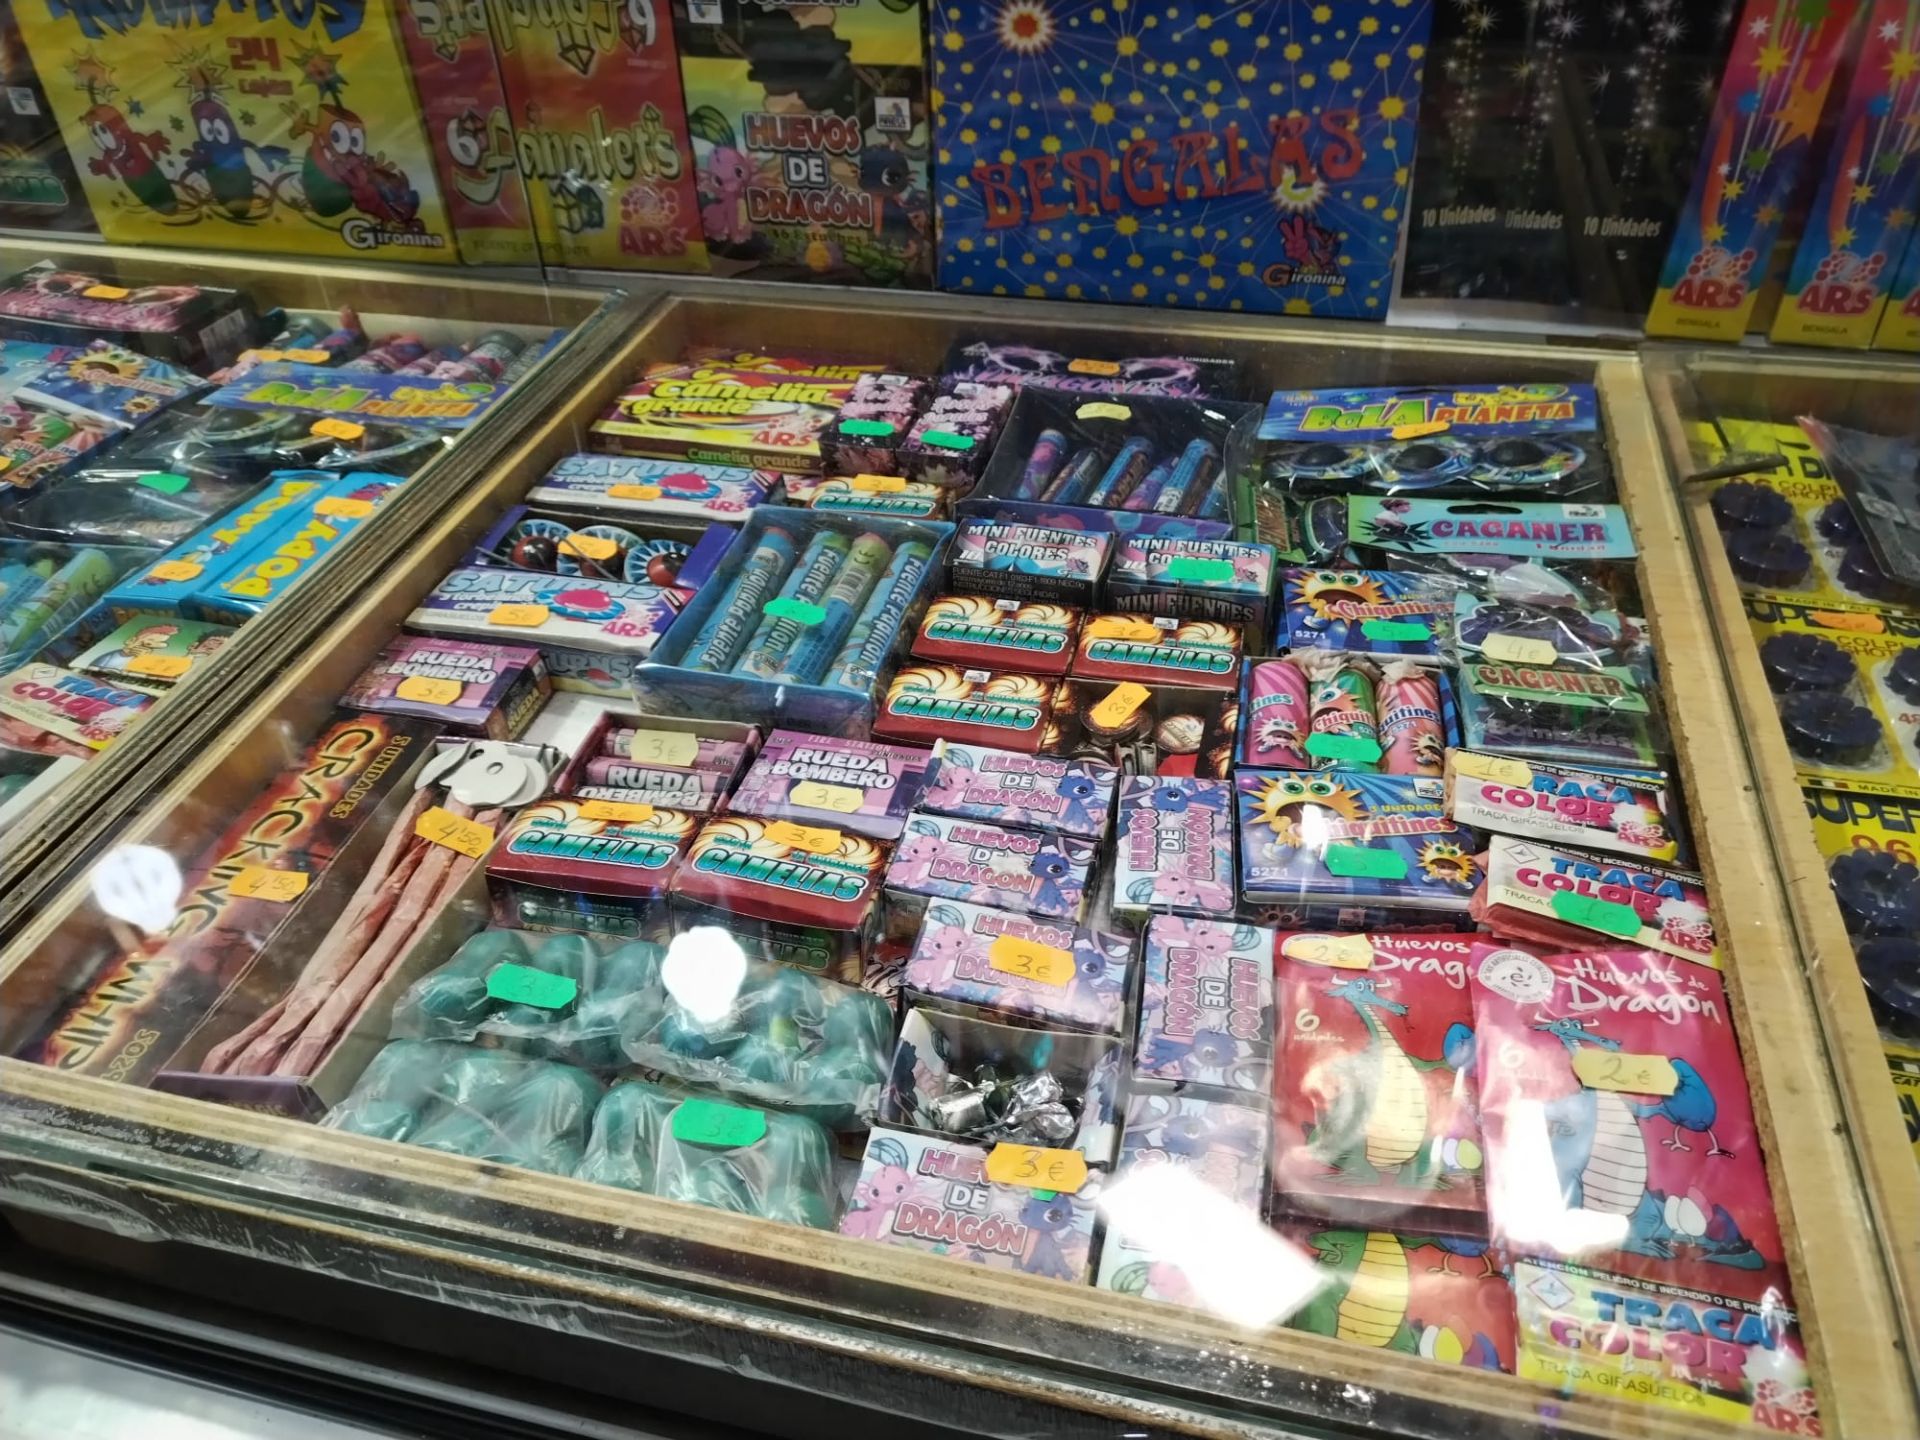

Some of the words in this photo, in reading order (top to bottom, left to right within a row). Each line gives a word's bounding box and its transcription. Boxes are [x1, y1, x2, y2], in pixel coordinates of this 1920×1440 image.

[227, 37, 281, 71] 24
[743, 112, 862, 156] HUEVOS
[784, 156, 828, 184] DE
[972, 109, 1363, 229] BENGALAS
[746, 184, 872, 228] DRAGÓN
[1421, 209, 1437, 228] 10
[1439, 204, 1496, 226] Unidades
[1504, 209, 1564, 230] Unidades
[341, 219, 444, 249] Gironina
[619, 226, 690, 256] ARS
[1583, 216, 1599, 236] 10
[1600, 216, 1662, 238] Unidades
[1262, 264, 1347, 288] Gironina
[1671, 279, 1747, 309] ARS
[1798, 284, 1873, 315] ARS
[653, 380, 828, 404] Camelia
[632, 399, 754, 416] grande
[1431, 402, 1575, 426] PLANETA
[752, 431, 813, 447] ARS
[555, 457, 753, 484] SATURNS
[687, 448, 751, 465] Camelia
[753, 452, 812, 468] grande
[702, 499, 747, 512] ARS
[967, 523, 1011, 540] MINI
[1013, 526, 1098, 549] FUENTES
[1430, 520, 1608, 542] CAGANER
[228, 518, 340, 598] POPY
[984, 539, 1070, 562] COLORES
[1128, 539, 1170, 551] MINI
[1174, 540, 1262, 560] FUENTES
[443, 570, 665, 600] SATURNS
[1116, 594, 1158, 612] MINI
[1167, 594, 1255, 622] FUENTES
[601, 621, 652, 638] ARS
[700, 617, 743, 670] Fuente
[924, 619, 1069, 653] CAMELIAS
[1294, 629, 1328, 641] 5271
[408, 650, 494, 671] RUEDA
[1085, 639, 1235, 675] CAMELIAS
[387, 662, 497, 686] BOMBERO
[1477, 665, 1625, 699] CAGANER
[12, 681, 118, 720] COLOR
[53, 675, 150, 709] TRACA
[888, 693, 1042, 731] CAMELIAS
[770, 760, 897, 790] BOMBERO
[791, 747, 889, 775] RUEDA
[980, 754, 1069, 778] HUEVOS
[606, 765, 702, 793] RUEDA
[1003, 772, 1034, 788] DE
[1532, 776, 1637, 805] RACA
[1856, 783, 1899, 794] MADE
[963, 785, 1063, 813] DRAGÓN
[1481, 785, 1616, 828] COLOR
[1471, 806, 1508, 822] TRACA
[507, 829, 680, 870] CAMELIAS
[949, 824, 1042, 855] HUEVOS
[1128, 808, 1161, 871] HUEVOS
[1160, 826, 1181, 853] DE
[1185, 807, 1215, 880] DRAGÓN
[692, 847, 869, 903] CAMELIAS
[1250, 866, 1290, 877] 5271
[1551, 855, 1686, 902] TRACA
[1590, 854, 1602, 863] DE
[1602, 857, 1642, 872] INCENDIO
[1652, 867, 1665, 877] DE
[1503, 888, 1544, 906] TRACA
[1516, 868, 1663, 922] COLOR
[974, 913, 1075, 950] HUEVOS
[1369, 935, 1472, 954] Huevos
[1660, 929, 1714, 955] ARS
[1014, 953, 1053, 977] 3€
[1370, 950, 1474, 990] Drag
[1574, 958, 1685, 986] Huevos
[1688, 974, 1710, 993] de
[1203, 976, 1225, 1009] DE
[1228, 957, 1261, 1040] HUEVOS
[1568, 977, 1722, 1027] Dragón
[57, 958, 174, 1071] WHIP
[1295, 1008, 1320, 1032] 6
[1015, 1149, 1066, 1183] 3€
[949, 1186, 989, 1209] DE
[893, 1202, 1029, 1256] DRAGÓN
[1593, 1271, 1640, 1289] PELIGRO
[1642, 1281, 1658, 1293] DE
[1659, 1284, 1712, 1304] INCENDIO
[1725, 1298, 1740, 1310] DE
[1591, 1289, 1778, 1351] TRACA
[1550, 1316, 1749, 1381] COLOR
[1537, 1358, 1592, 1383] TRACA
[1752, 1401, 1825, 1438] ARS
